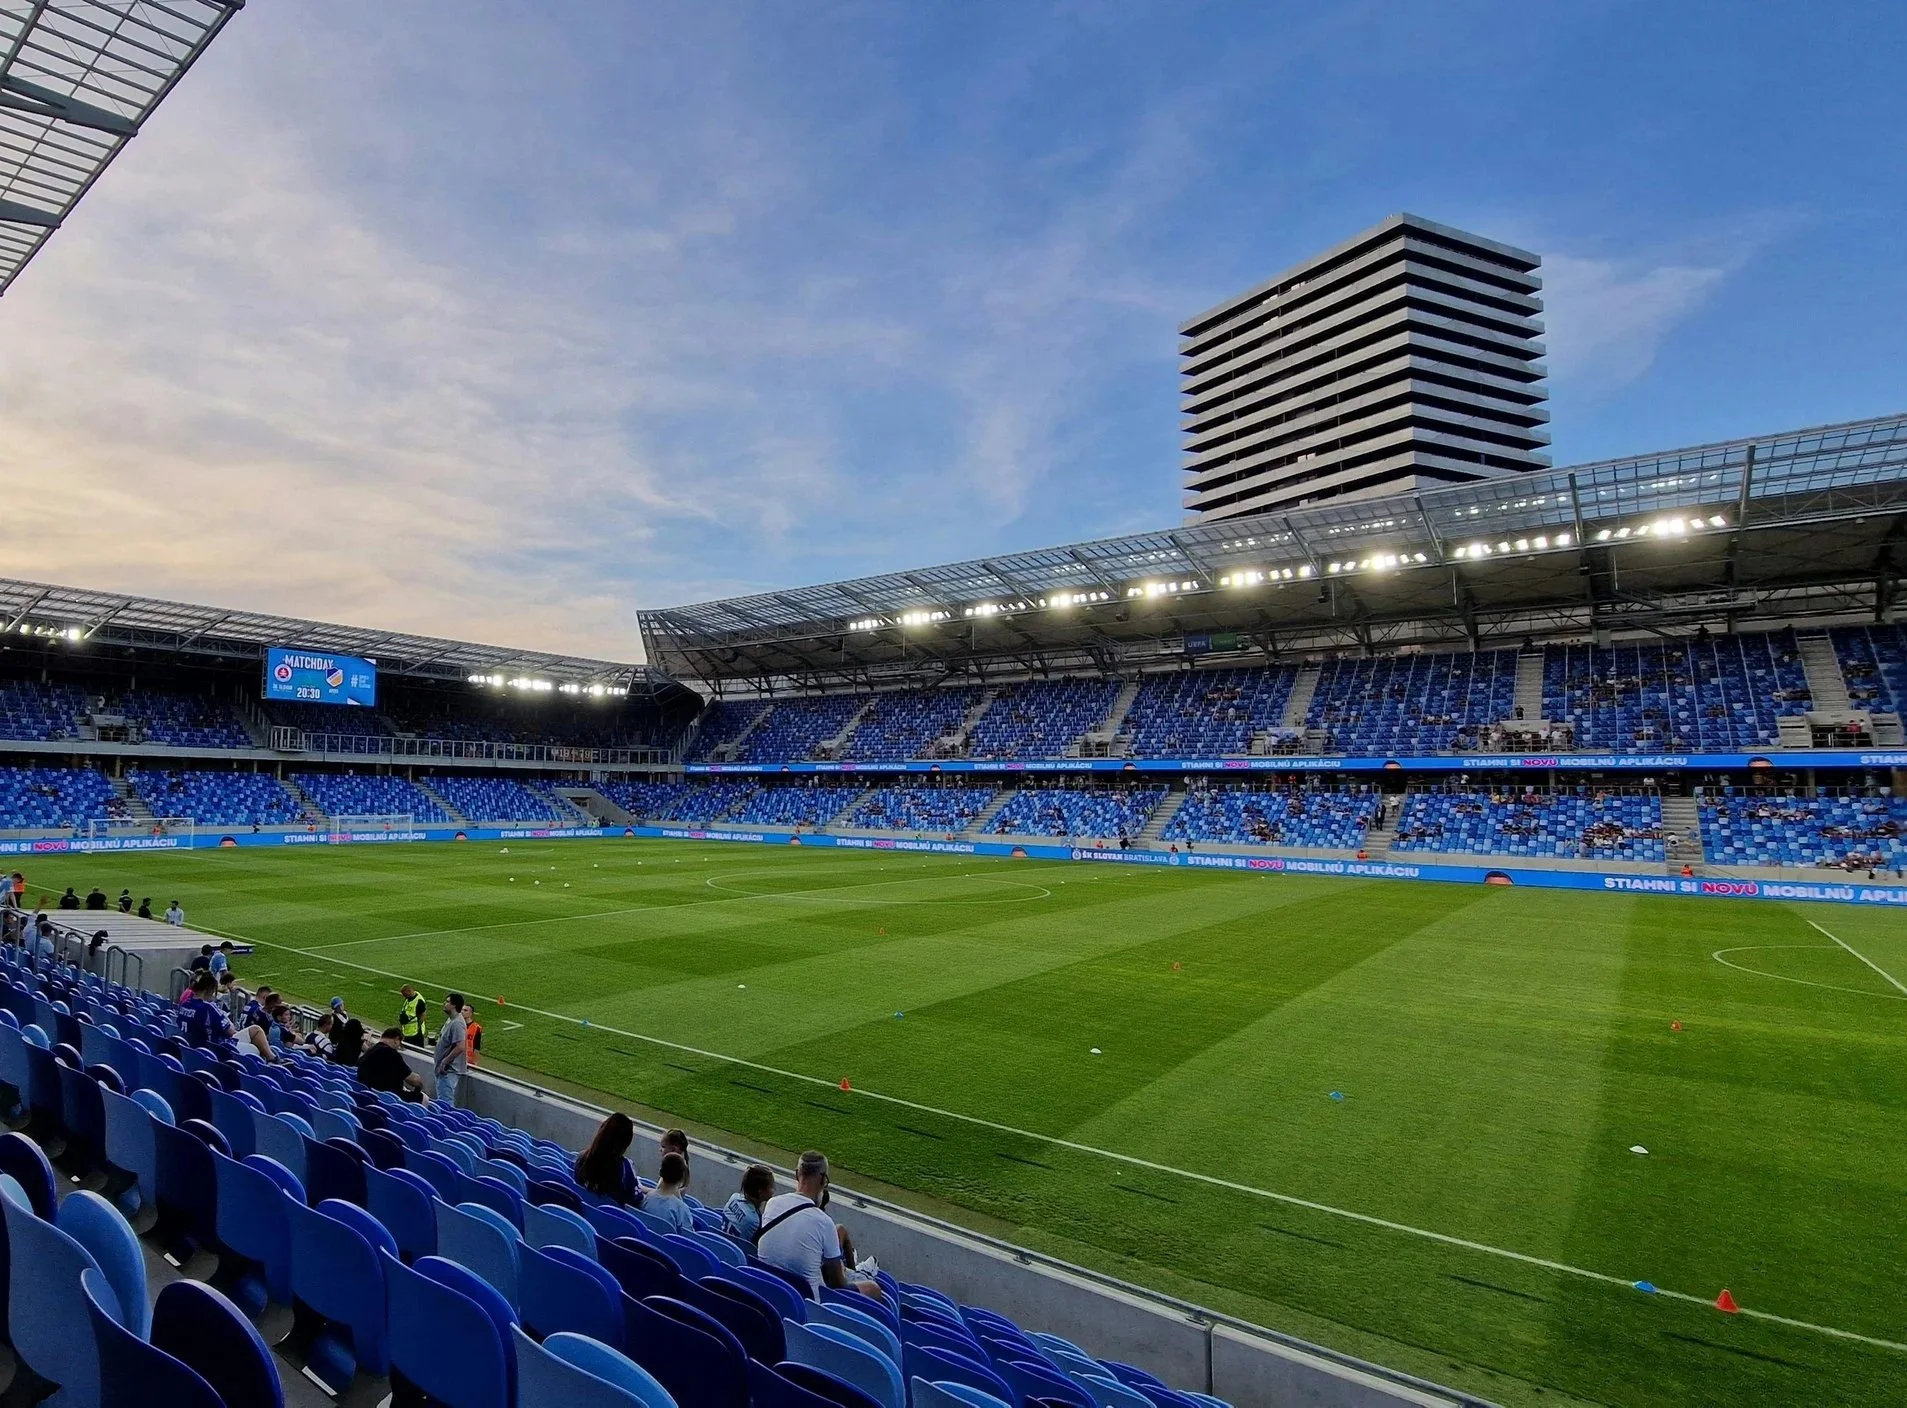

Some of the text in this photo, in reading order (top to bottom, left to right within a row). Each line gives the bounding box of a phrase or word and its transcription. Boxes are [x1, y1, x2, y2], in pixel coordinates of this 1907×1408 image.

[284, 655, 334, 670] MATCHDAY
[297, 687, 320, 698] 20:30
[1292, 759, 1341, 768] APLIKÁCIU
[1463, 758, 1508, 767] STIAHNI
[1511, 758, 1521, 766] SI
[1560, 756, 1616, 766] MOBILNÚ
[1618, 755, 1688, 766] APLIKÁCIU
[20, 842, 32, 852] SI
[33, 840, 69, 852] NOVÚ
[70, 838, 121, 850] MOBILNÚ
[122, 837, 177, 848] APLIKÁCIU
[1124, 853, 1168, 863] BRATISLAVA
[1187, 855, 1232, 867] STIAHNI
[1234, 857, 1246, 867] SI
[1286, 860, 1343, 873] MOBILNÚ
[1346, 863, 1419, 877] APLIKÁCIU
[1604, 877, 1676, 892] STIAHNI
[1680, 879, 1697, 893] SI
[1702, 880, 1759, 896] NOVÚ
[1763, 884, 1853, 901] MOBILNÚ
